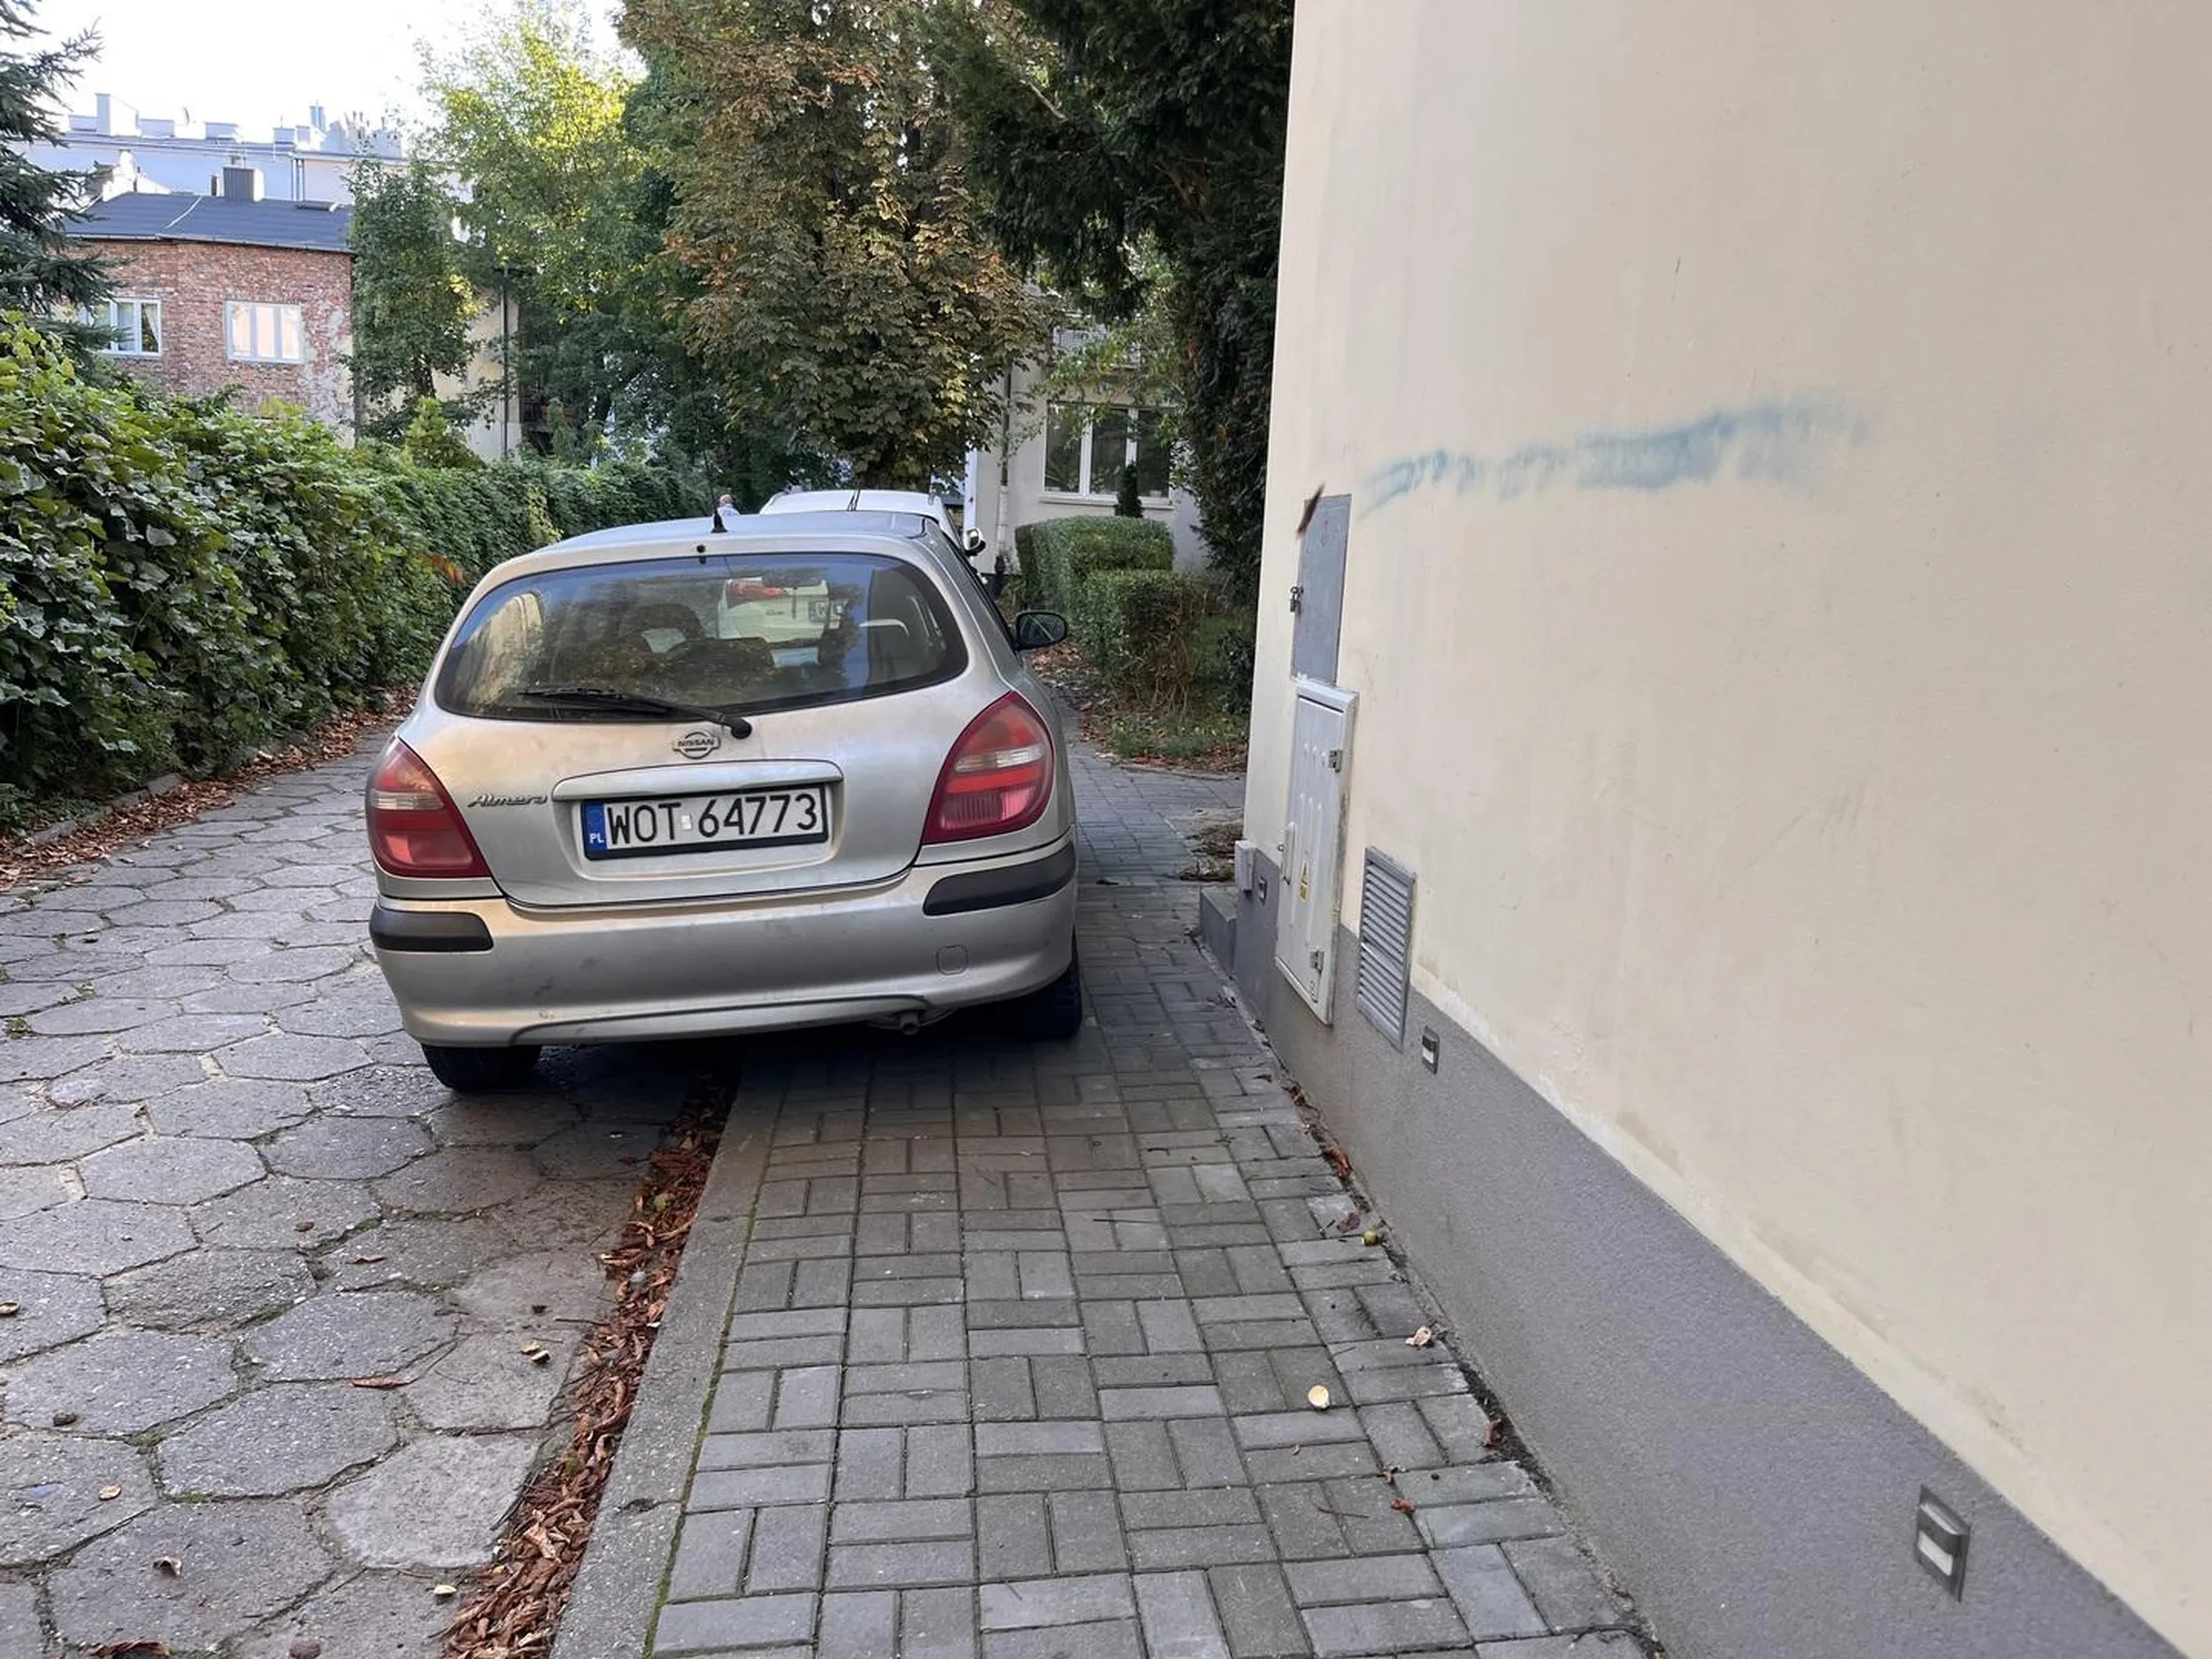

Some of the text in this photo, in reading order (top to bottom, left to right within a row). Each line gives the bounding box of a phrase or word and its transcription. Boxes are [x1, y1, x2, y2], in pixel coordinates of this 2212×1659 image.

[678, 738, 714, 747] NISSAN
[606, 793, 818, 845] WOT 64773
[589, 832, 604, 844] PL
